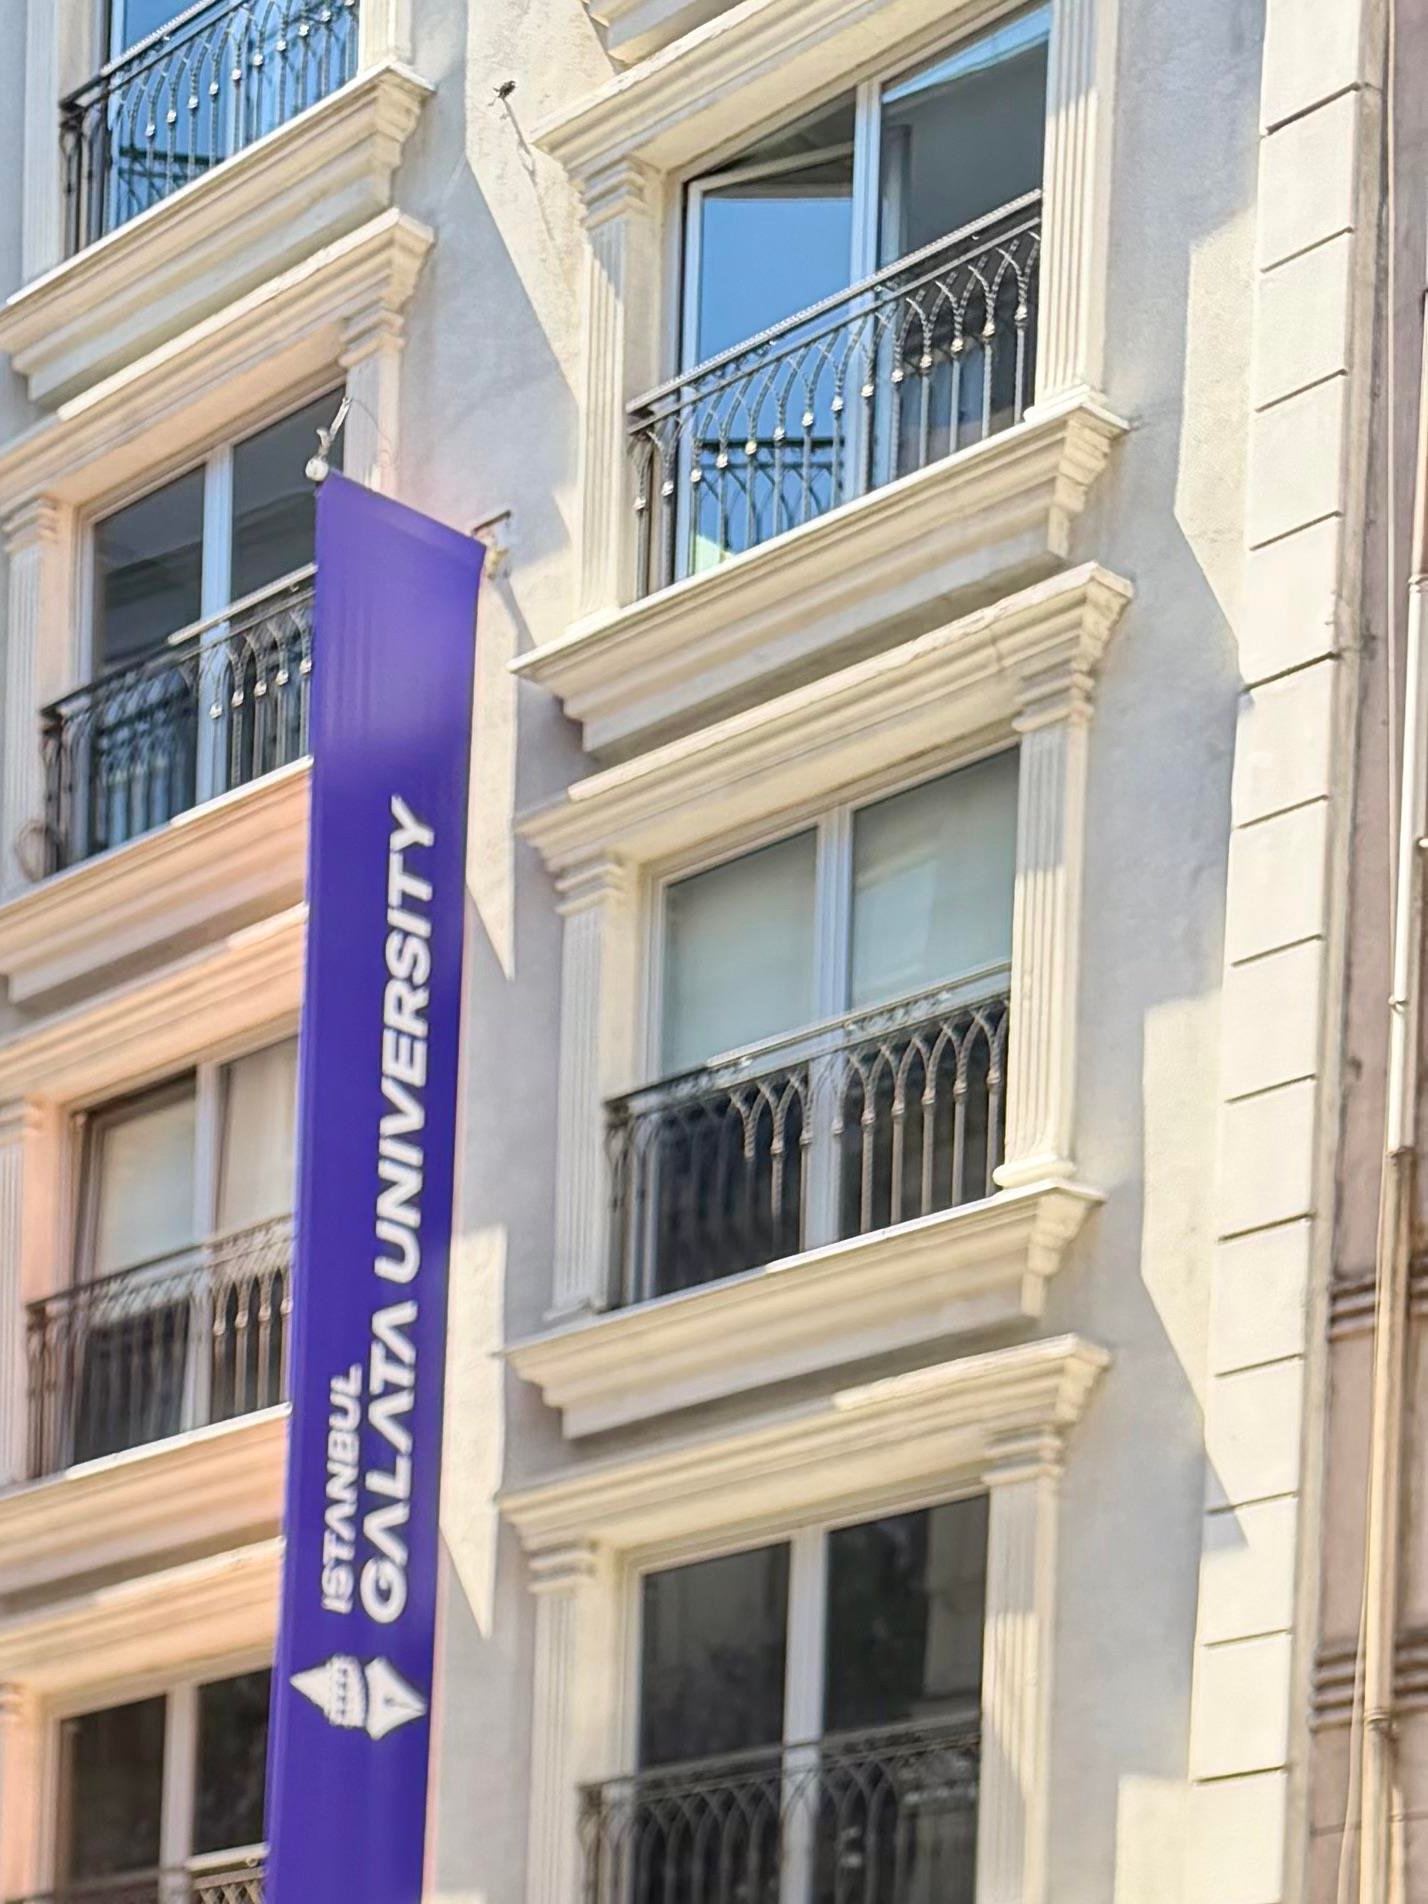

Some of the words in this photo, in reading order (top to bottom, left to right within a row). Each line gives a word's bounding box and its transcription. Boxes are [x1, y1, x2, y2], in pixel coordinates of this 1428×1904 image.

[374, 793, 434, 1284] UNIVERSITY
[321, 1363, 362, 1614] ISTANBUL
[360, 1300, 418, 1624] GALATA
